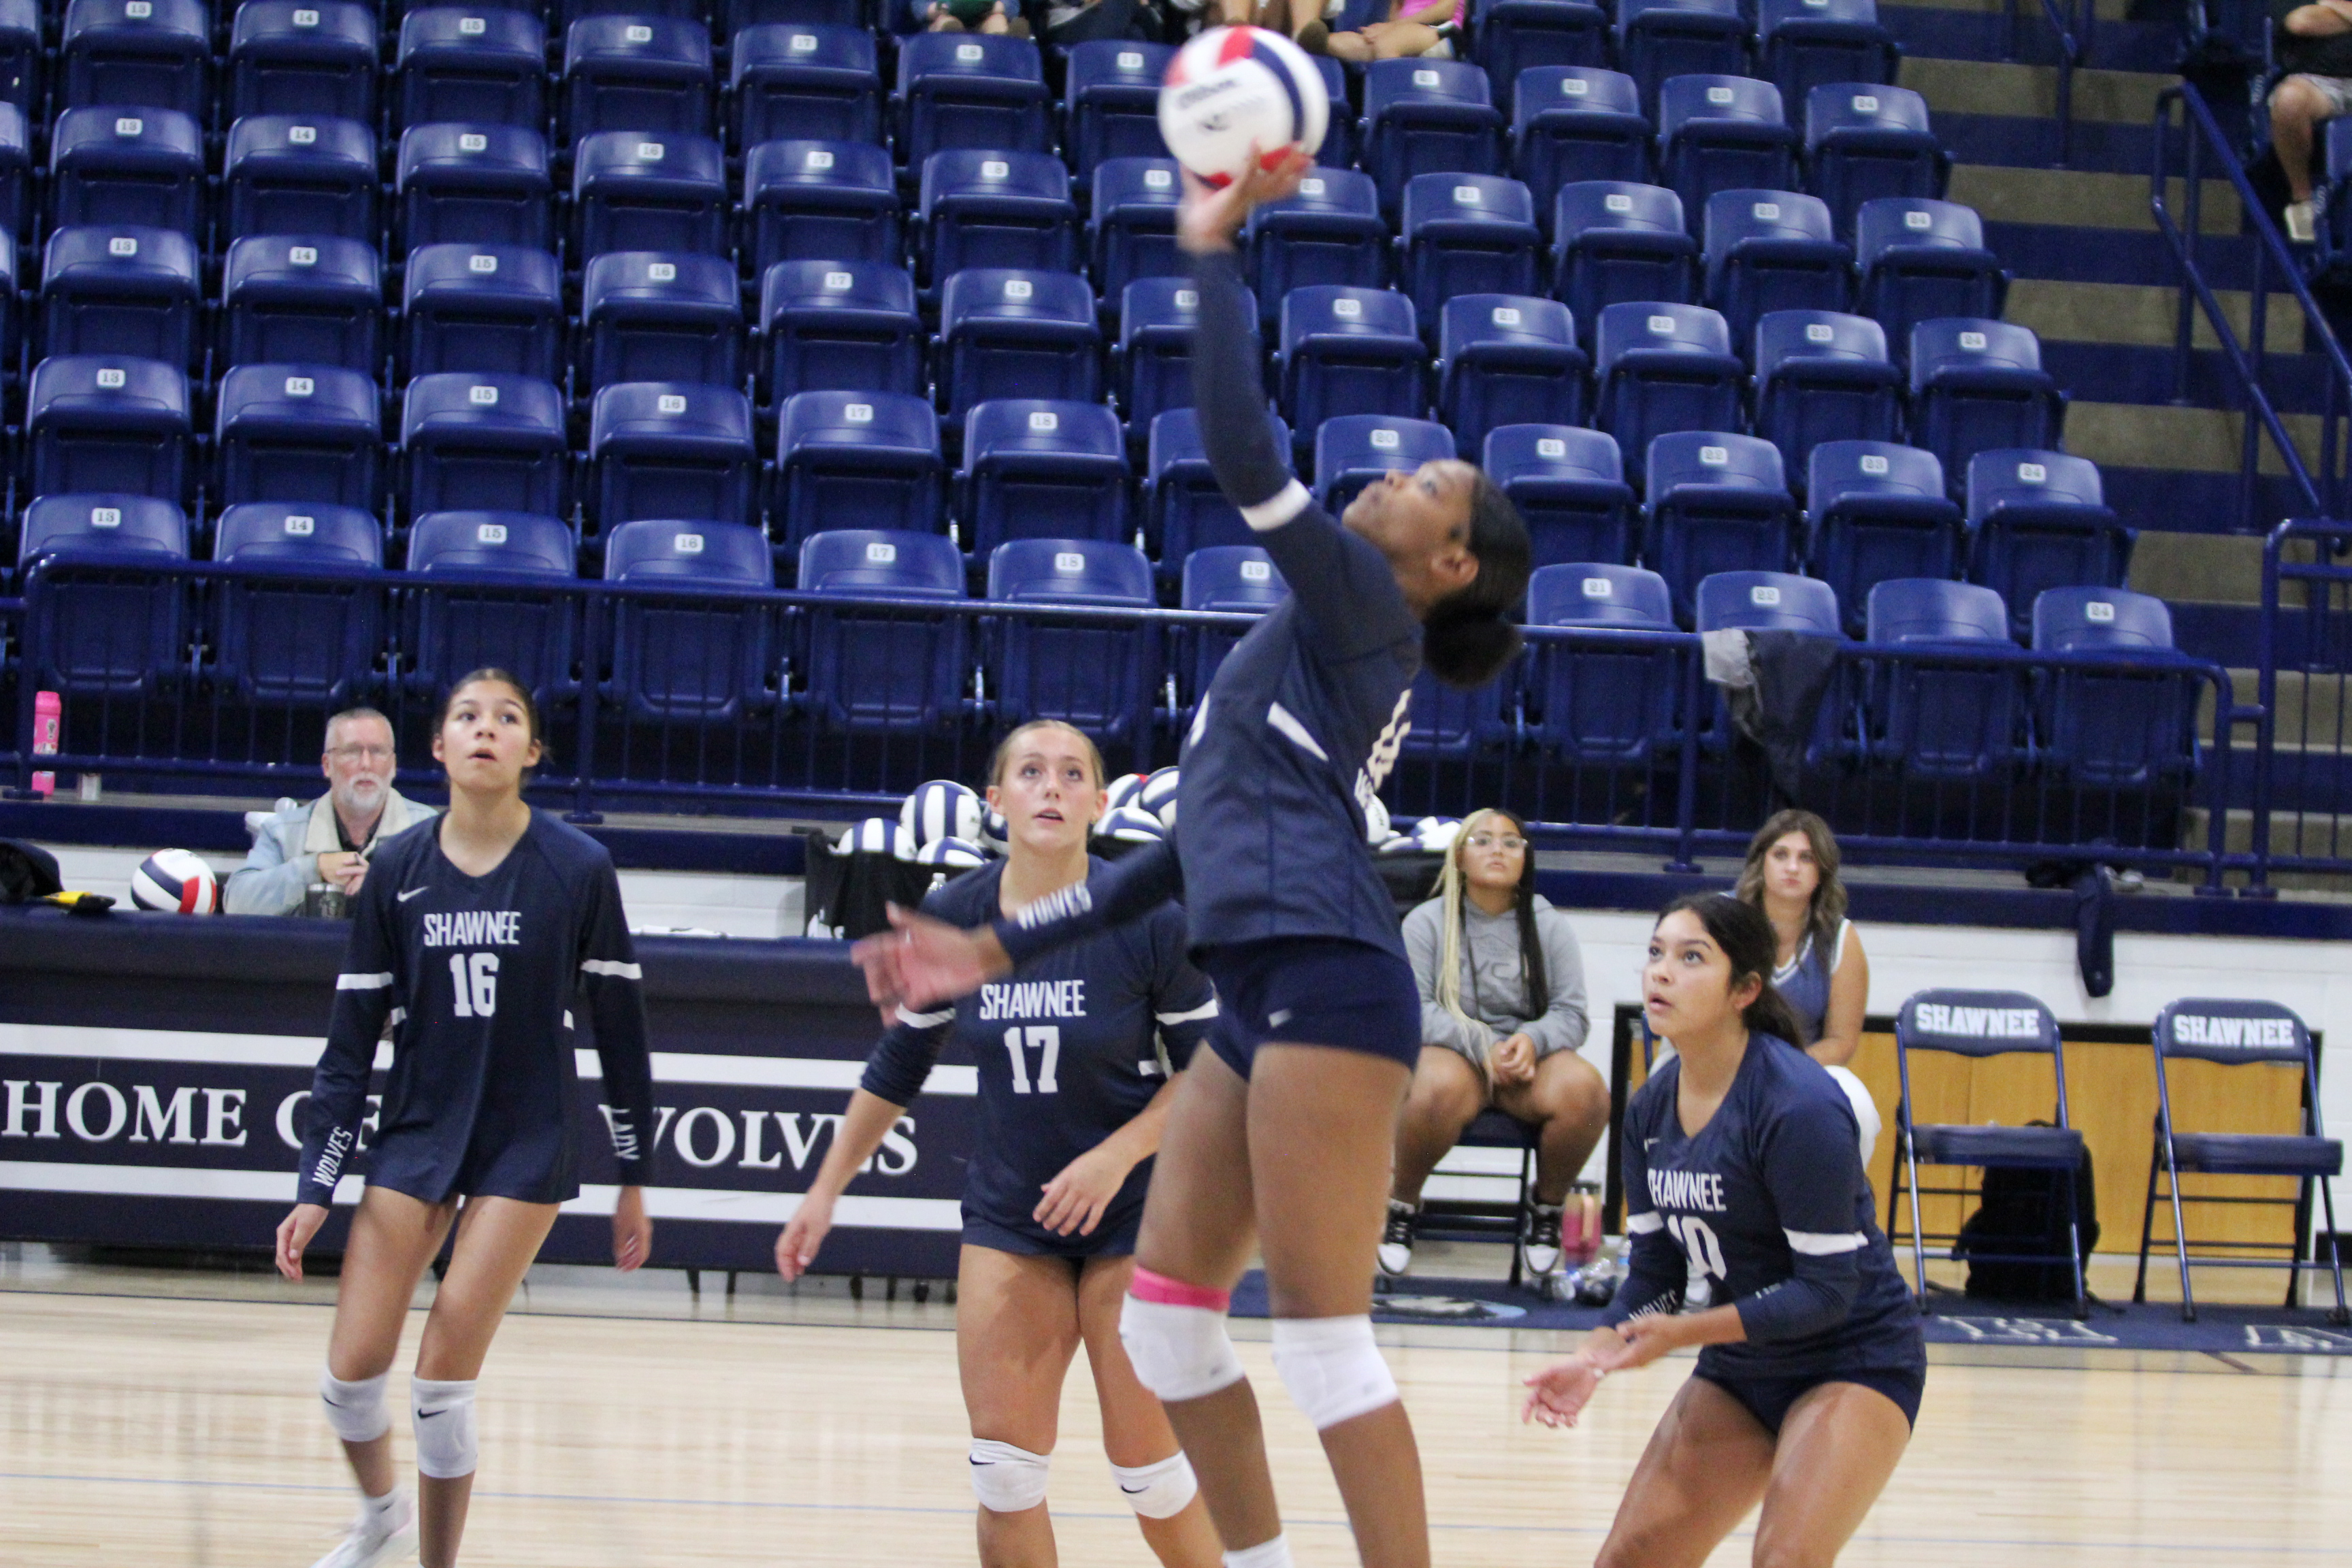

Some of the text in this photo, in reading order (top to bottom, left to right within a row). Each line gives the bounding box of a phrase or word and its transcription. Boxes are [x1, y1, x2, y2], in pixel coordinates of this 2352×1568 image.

[130, 2, 147, 14] 13
[299, 12, 313, 22] 14
[121, 121, 137, 131] 13
[294, 129, 310, 140] 14
[466, 136, 482, 148] 15
[643, 145, 659, 157] 16
[115, 240, 132, 251] 13
[295, 250, 312, 261] 14
[475, 258, 491, 269] 15
[654, 266, 671, 277] 16
[830, 275, 847, 285] 17
[1009, 283, 1027, 293] 18
[1499, 310, 1515, 322] 21
[1965, 334, 1982, 345] 24
[102, 372, 120, 383] 13
[291, 380, 308, 391] 14
[476, 389, 492, 400] 15
[664, 398, 681, 410] 16
[850, 407, 867, 418] 17
[1034, 414, 1052, 426] 18
[1375, 432, 1395, 443] 20
[1543, 441, 1559, 453] 21
[1705, 448, 1723, 460] 22
[2023, 466, 2042, 478] 24
[97, 510, 115, 523] 13
[291, 519, 308, 531] 14
[484, 527, 502, 539] 15
[681, 537, 698, 549] 16
[872, 547, 889, 559] 17
[1060, 556, 1079, 568] 18
[1247, 564, 1264, 576] 19
[1588, 581, 1605, 593] 21
[1756, 589, 1776, 601] 22
[2090, 605, 2110, 617] 24
[423, 911, 521, 947] SHAWNEE
[449, 953, 500, 1017] 16
[979, 979, 1087, 1020] SHAWNEE
[1914, 1003, 2040, 1037] SHAWNEE
[2173, 1014, 2296, 1049] SHAWNEE
[1003, 1026, 1060, 1094] 17
[1, 1080, 248, 1147] HOME
[597, 1104, 919, 1176] WOLVS
[312, 1126, 353, 1187] WOLVES
